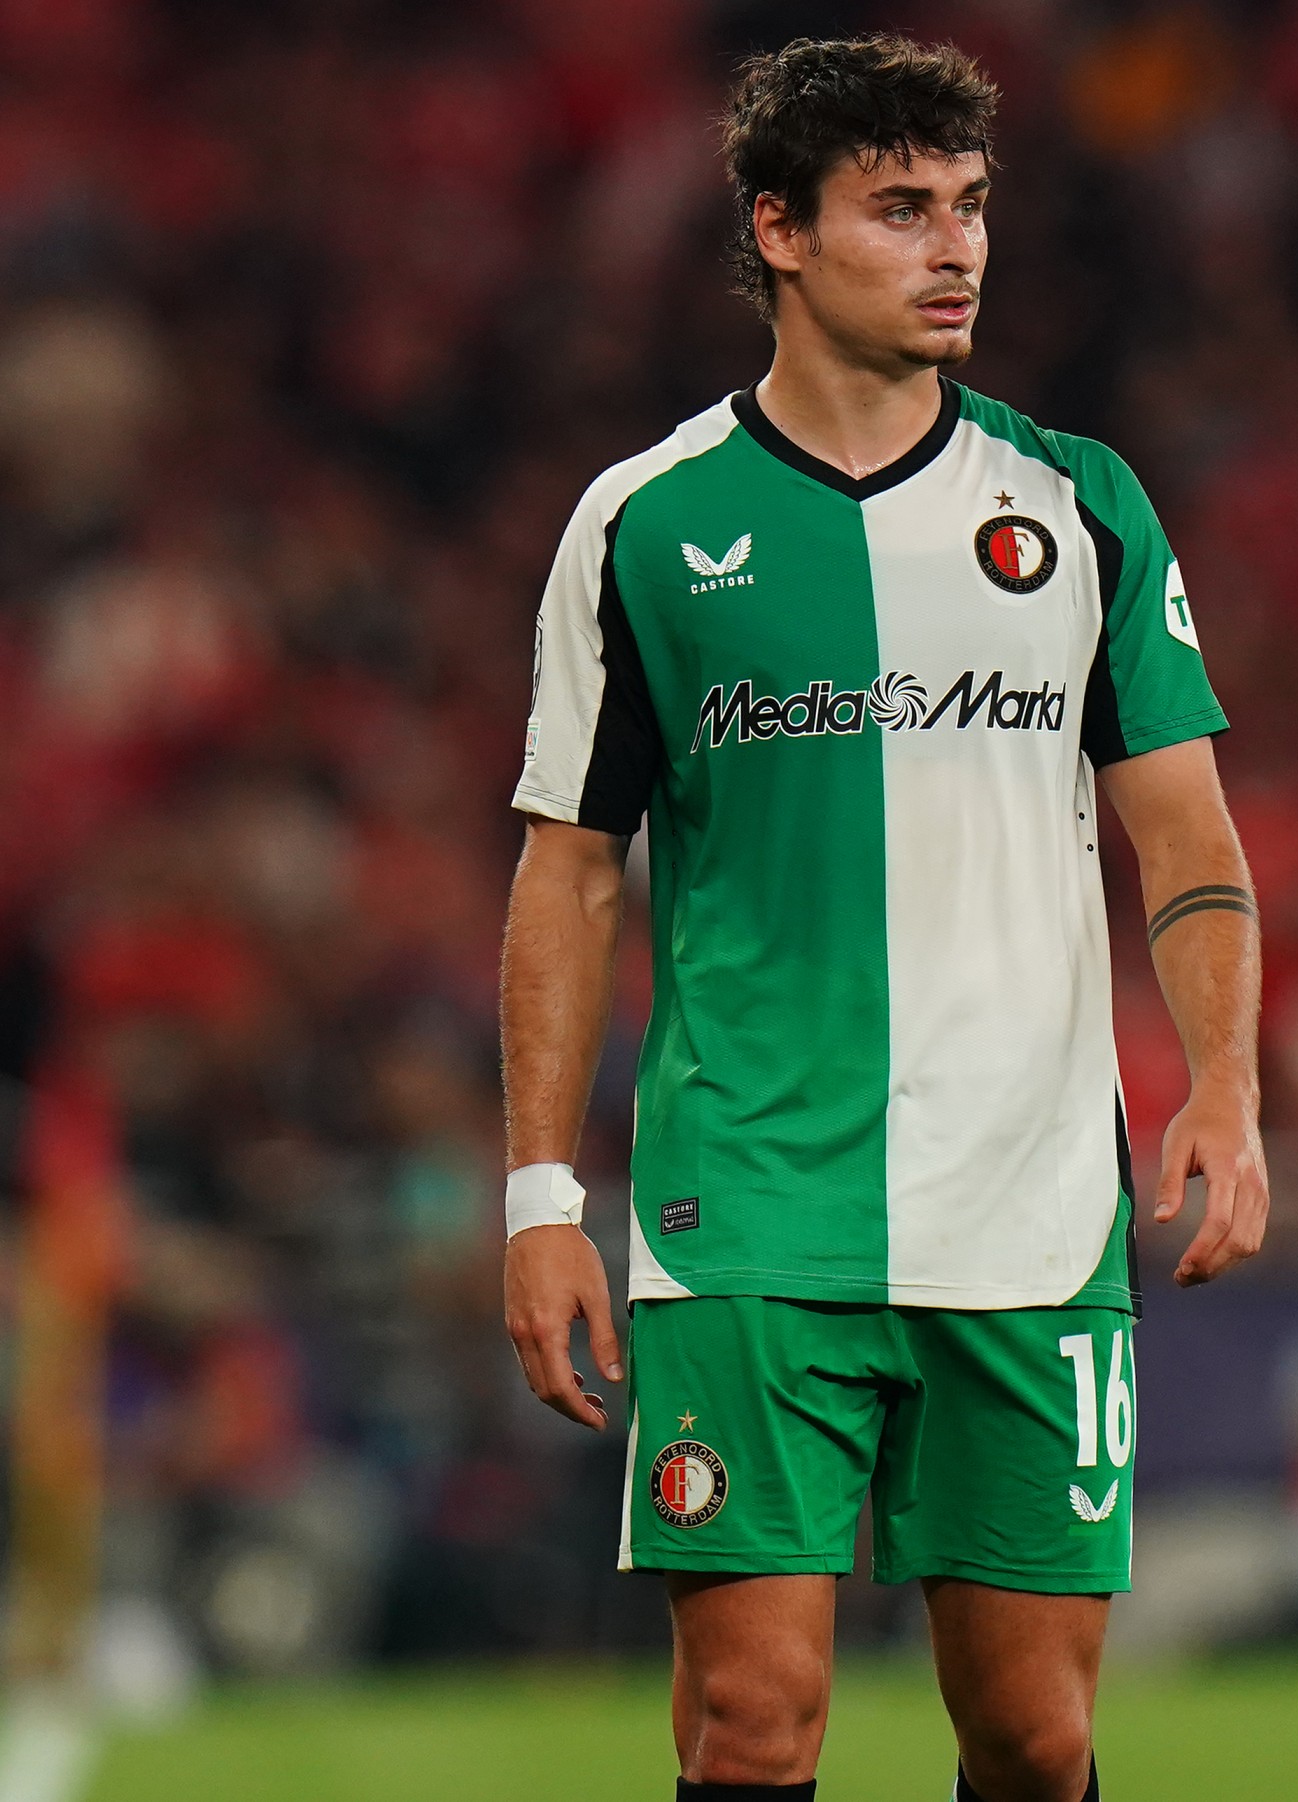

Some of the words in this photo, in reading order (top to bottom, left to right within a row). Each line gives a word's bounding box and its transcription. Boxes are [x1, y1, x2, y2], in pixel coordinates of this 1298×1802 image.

[979, 517, 1049, 540] FEYENOORD
[690, 574, 755, 595] CASTORE
[984, 561, 1054, 590] ROTTERDAM
[1170, 594, 1188, 628] T
[664, 1203, 693, 1216] CASTORE
[1059, 1328, 1132, 1468] 16
[654, 1444, 722, 1474] FEYENOORD
[653, 1494, 723, 1526] ROTTERDAM
